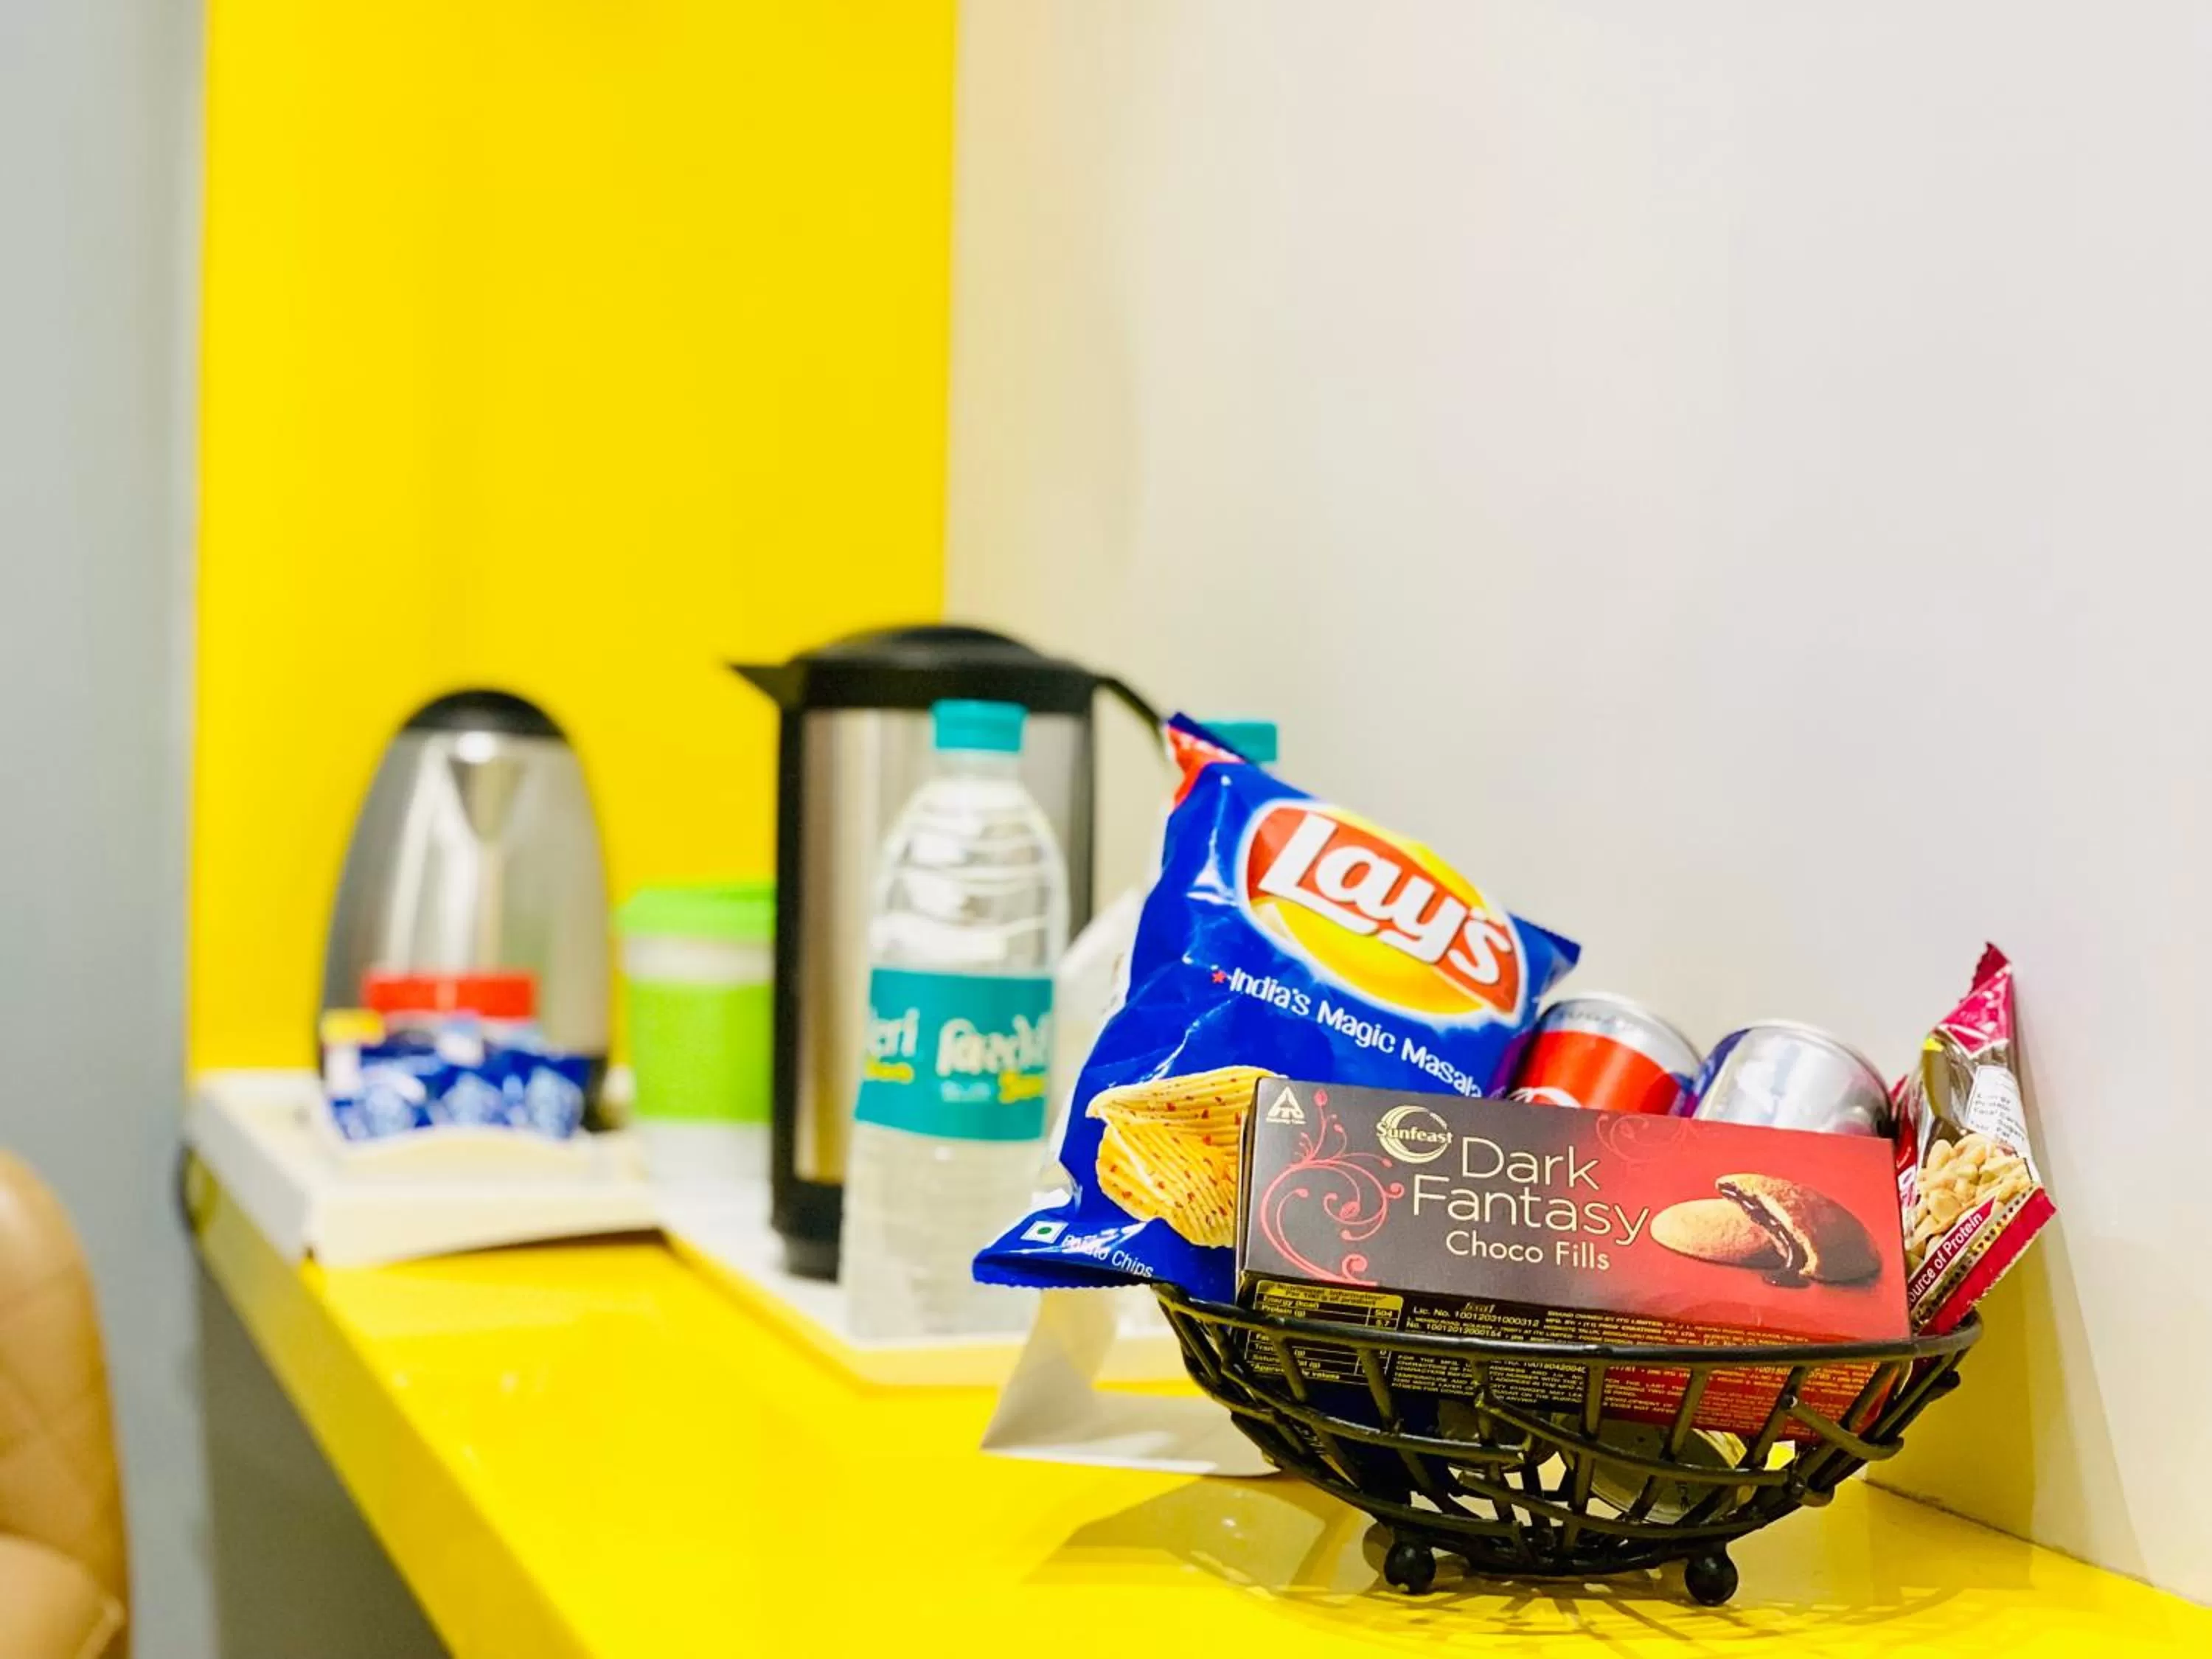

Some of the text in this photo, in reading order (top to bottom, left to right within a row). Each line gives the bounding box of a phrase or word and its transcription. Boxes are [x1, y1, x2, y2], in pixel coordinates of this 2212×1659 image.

[1258, 812, 1512, 985] Lay's
[1229, 967, 1312, 1016] India's
[1316, 1001, 1397, 1054] Magic
[1401, 1037, 1482, 1097] Masala
[1376, 1121, 1453, 1144] Sunfeast
[1462, 1136, 1599, 1191] Dark
[1413, 1174, 1650, 1246] Fantasy
[1112, 1250, 1154, 1278] Chips
[1446, 1230, 1544, 1263] Choco
[1556, 1241, 1610, 1271] Fills
[1909, 1212, 1983, 1304] ource of Protein
[1433, 1309, 1450, 1318] No.
